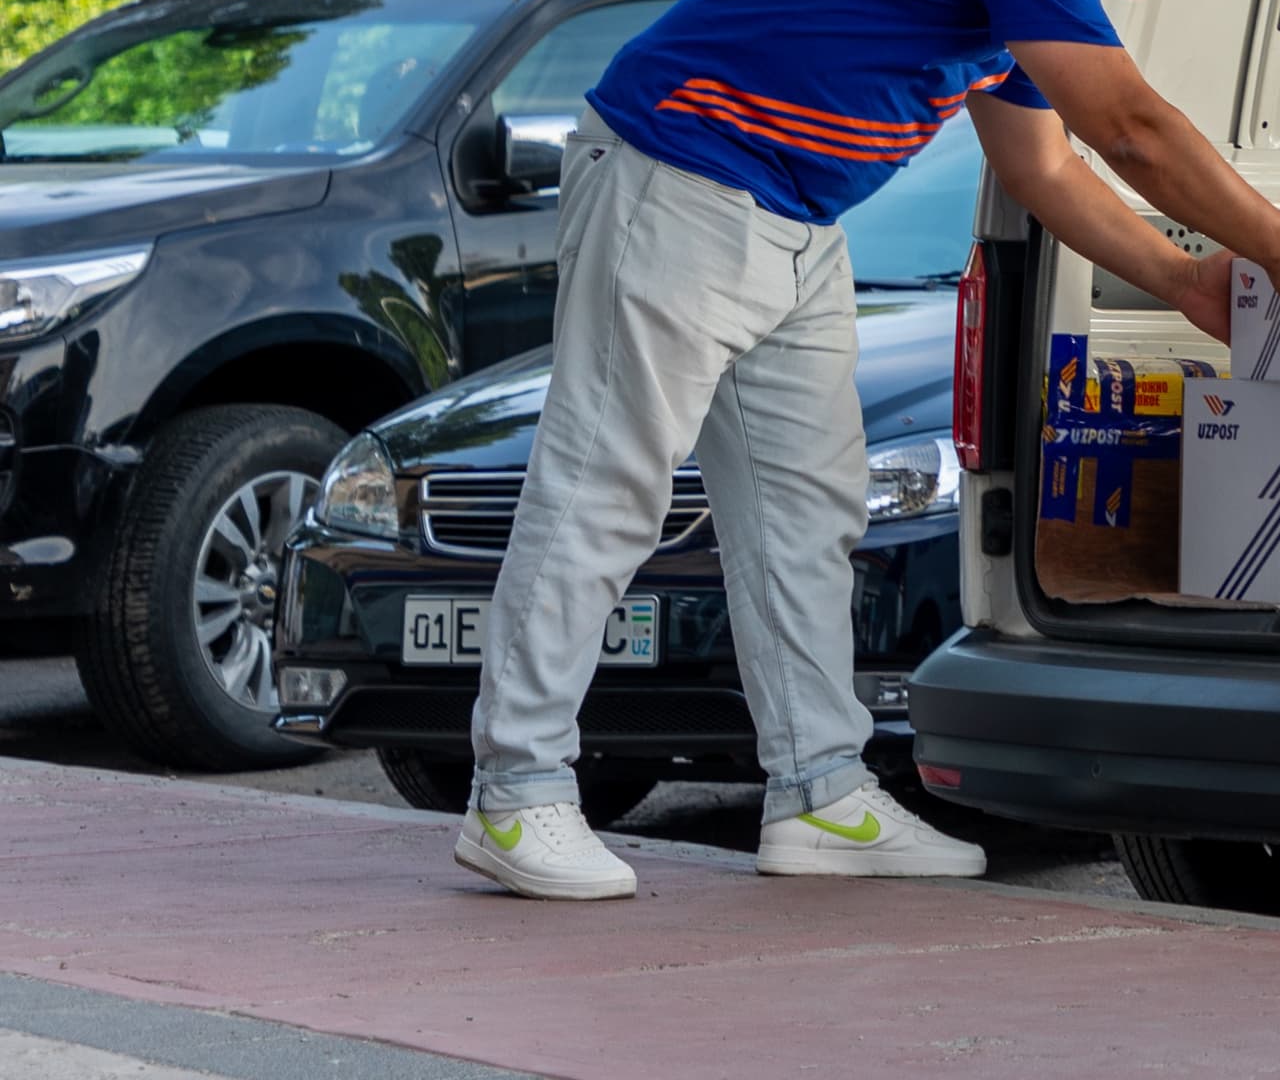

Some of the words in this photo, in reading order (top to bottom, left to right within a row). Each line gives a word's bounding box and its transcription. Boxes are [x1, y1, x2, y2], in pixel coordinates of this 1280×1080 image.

[1070, 428, 1122, 445] UZPOST
[1198, 423, 1240, 441] UZPOST
[414, 613, 447, 649] 01
[631, 640, 650, 655] UZ
